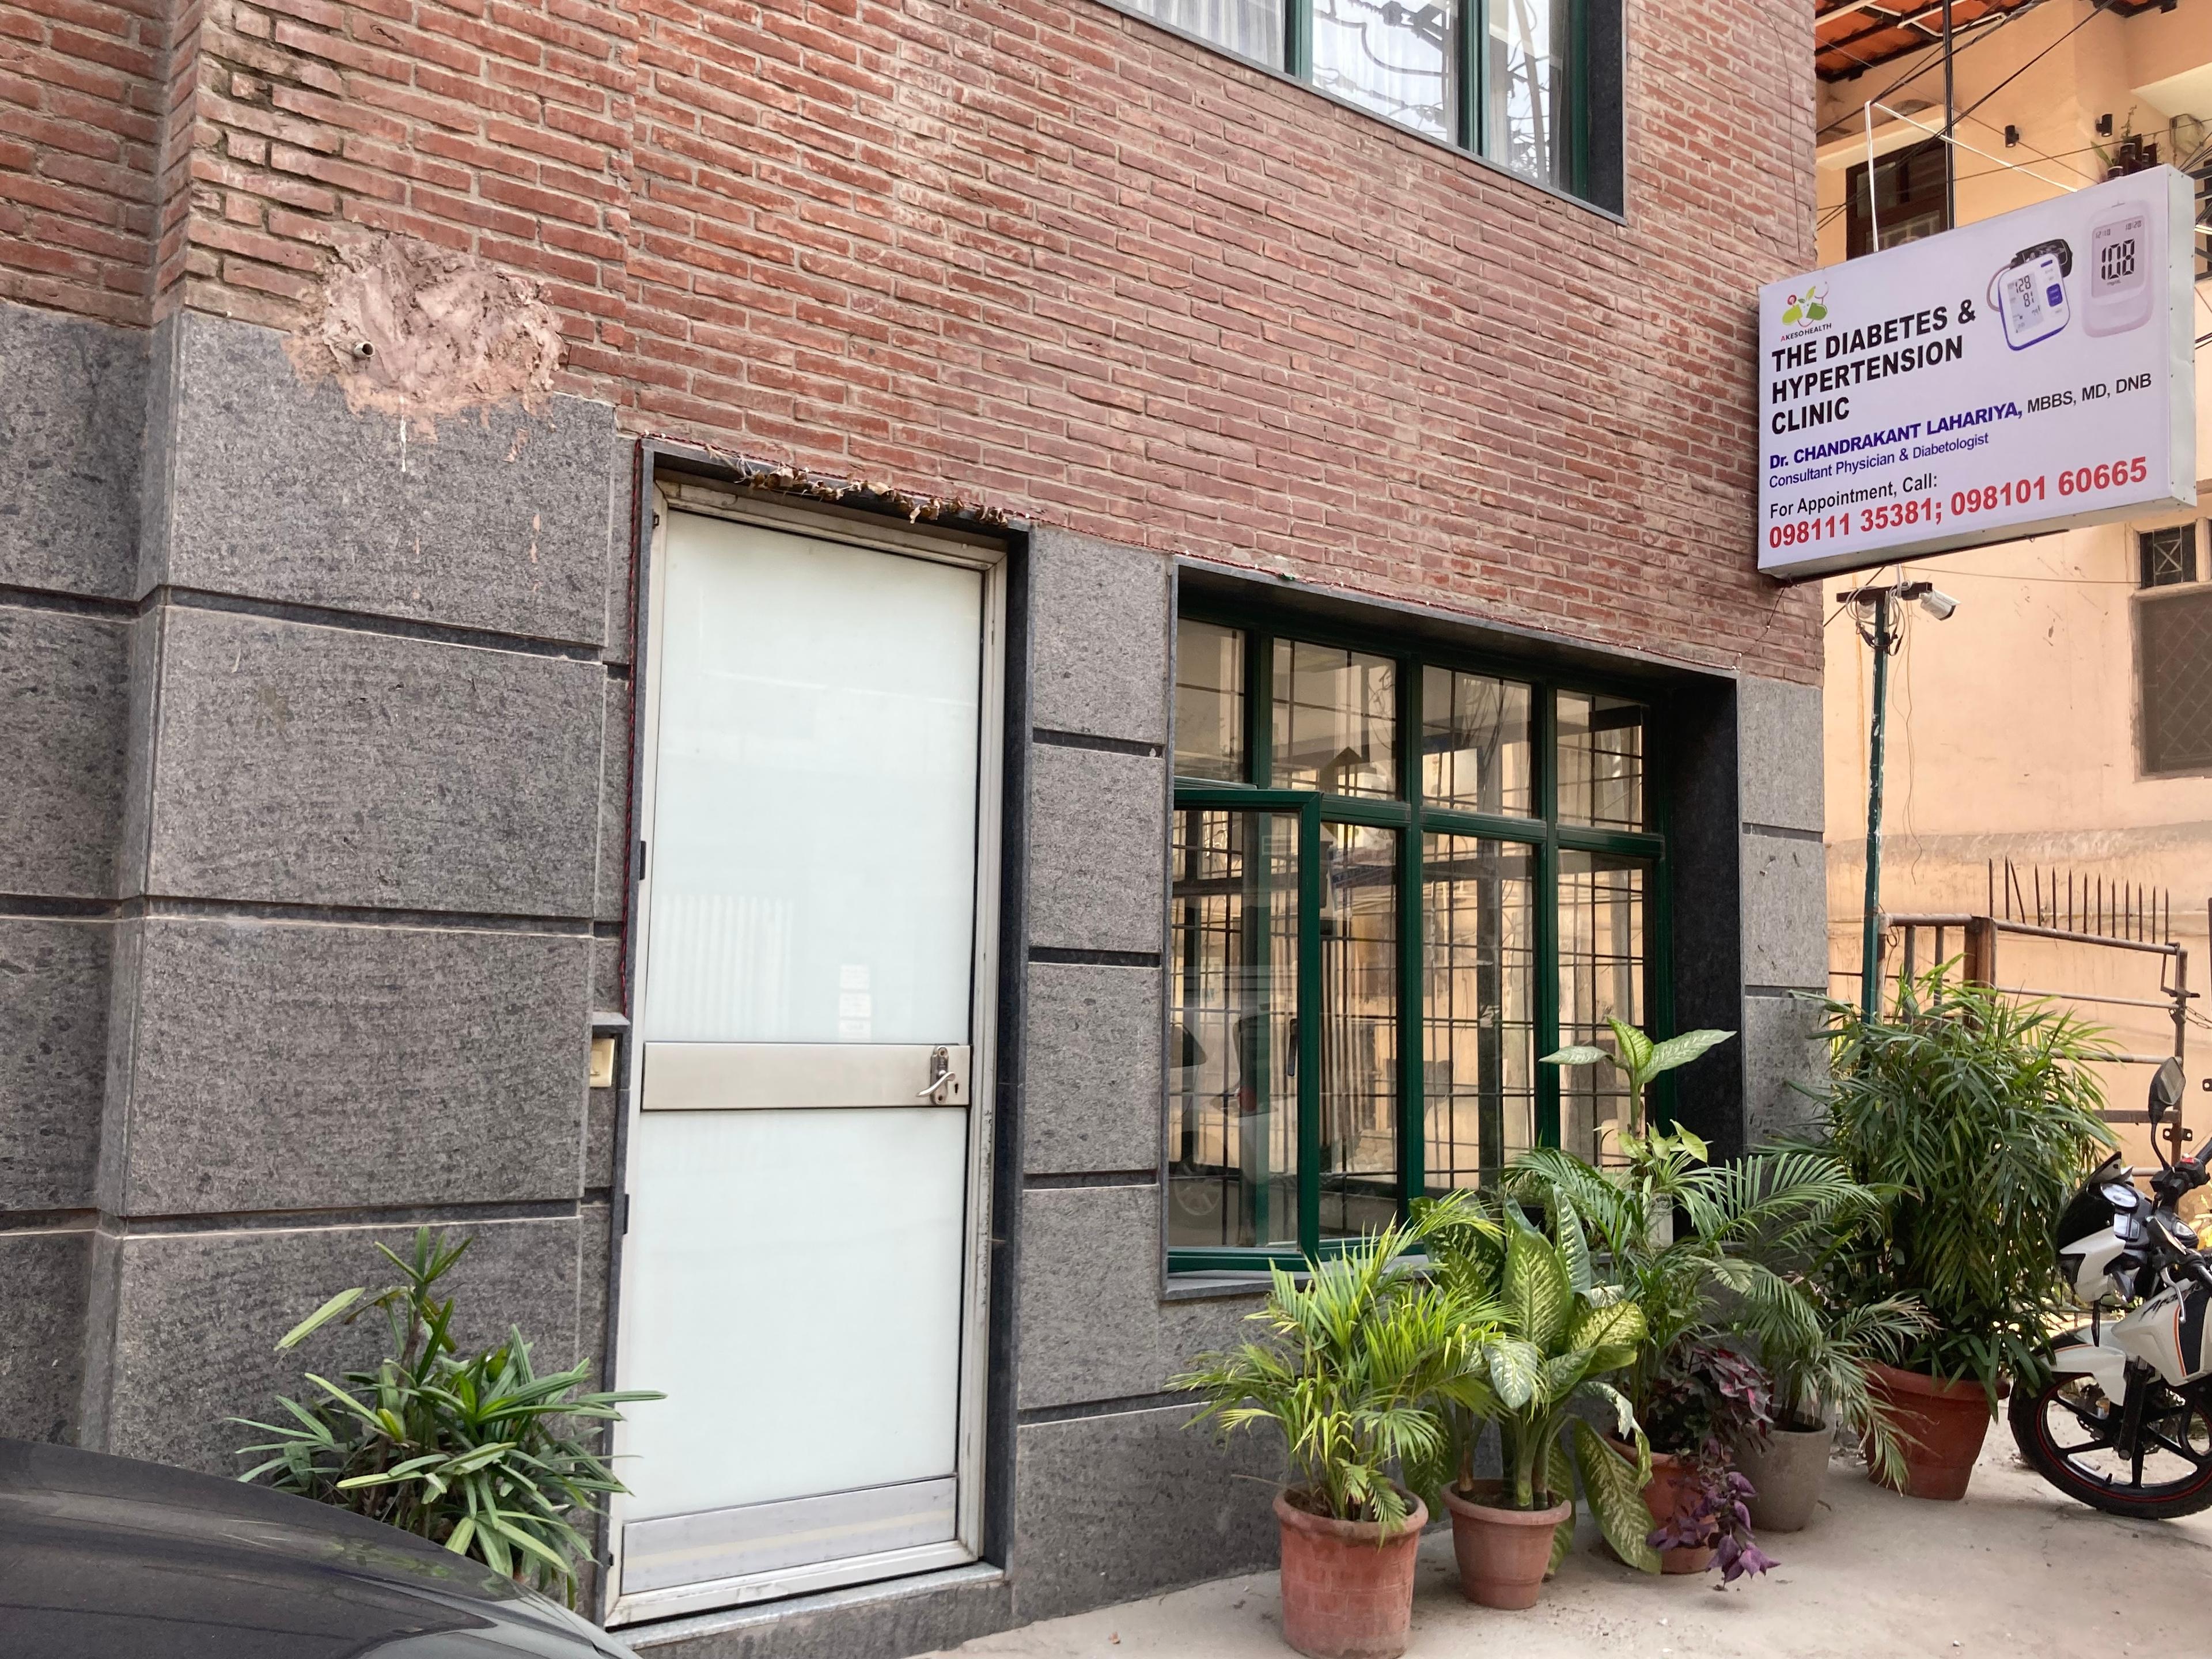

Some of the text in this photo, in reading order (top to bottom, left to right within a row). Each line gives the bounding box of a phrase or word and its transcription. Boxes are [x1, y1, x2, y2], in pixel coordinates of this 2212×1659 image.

[2015, 275, 2031, 293] 128
[2101, 238, 2135, 281] 108
[2023, 291, 2034, 307] 81
[1772, 299, 1976, 372] THE DIABETES &
[1772, 335, 1963, 404] HYPERTENSION
[1770, 373, 2152, 469] Dr. CHANDRAKANT LAHARIYA, MBBS, MD, DNB
[1772, 397, 1850, 434] CLINIC
[1769, 432, 1989, 488] Consultant Physician & Diabetologist
[1770, 472, 1937, 518] For Appointment, Call:
[1770, 456, 2147, 548] 098111 35381; 098101 60665
